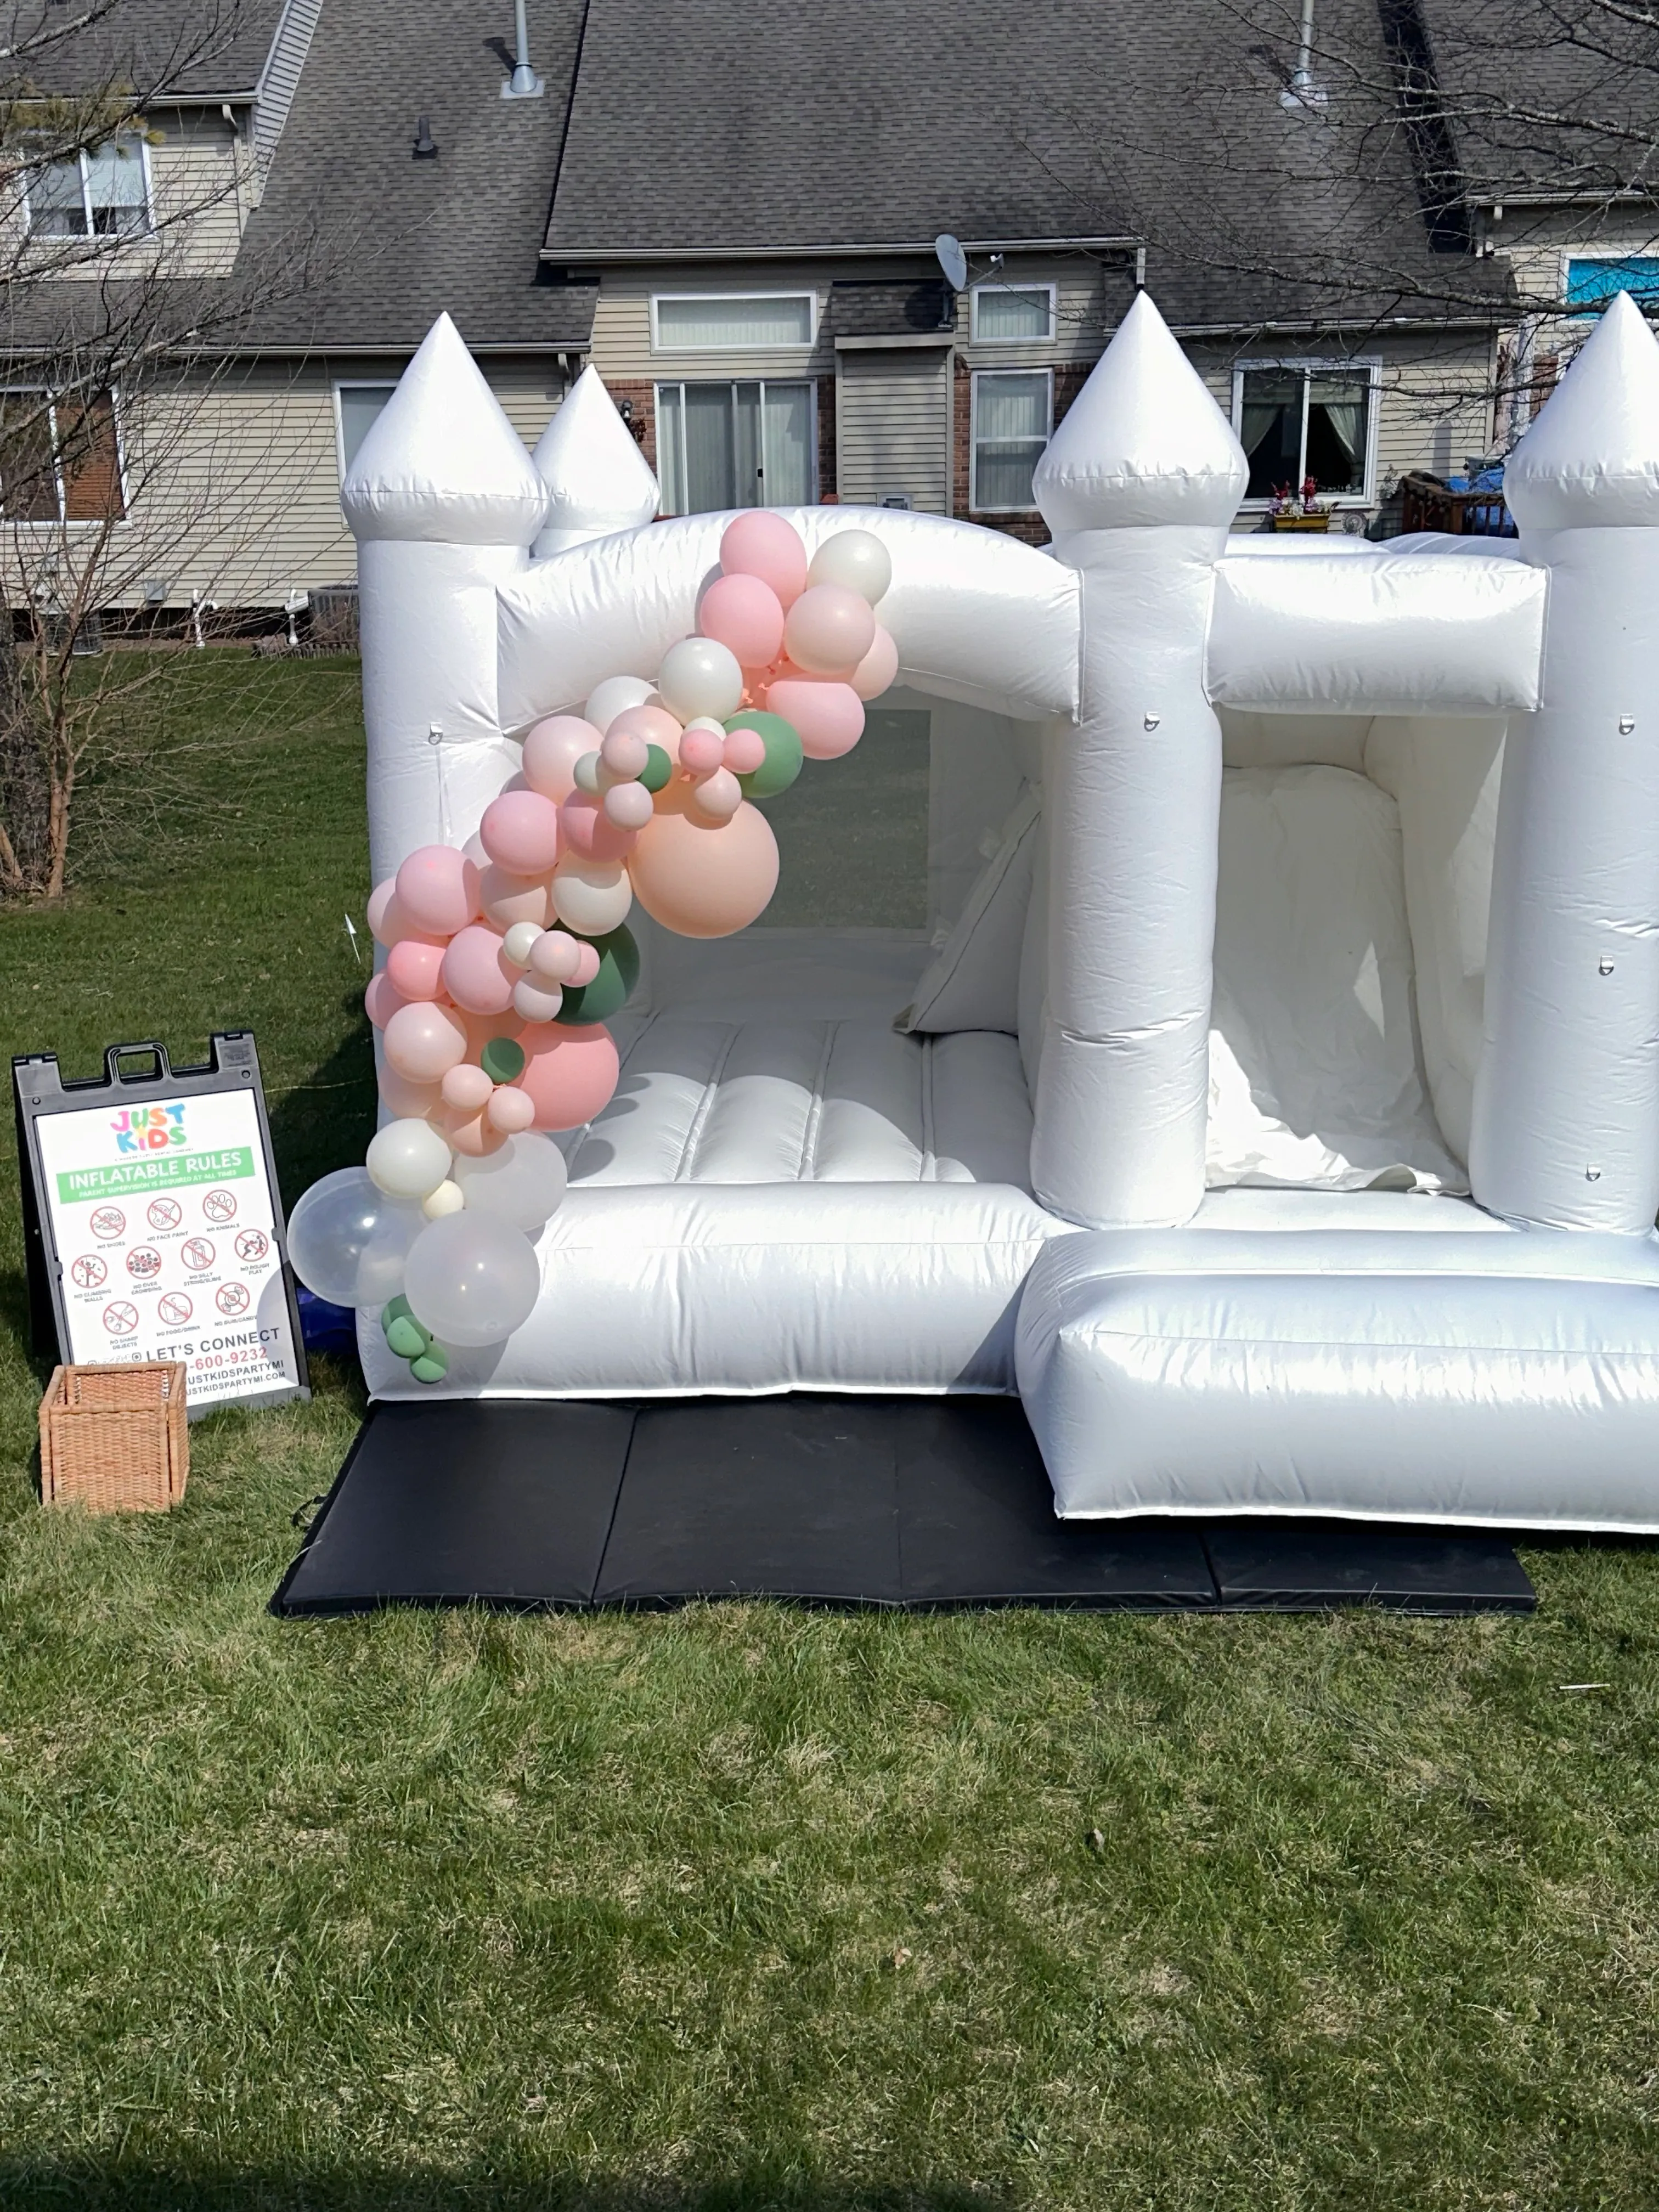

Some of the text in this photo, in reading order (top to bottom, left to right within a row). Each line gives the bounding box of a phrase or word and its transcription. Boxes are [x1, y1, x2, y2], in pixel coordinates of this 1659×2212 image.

[110, 1103, 185, 1132] JUST
[116, 1126, 187, 1154] KIDS
[69, 1160, 180, 1190] INFLATABLE
[185, 1152, 242, 1173] RULES
[79, 1188, 105, 1198] PARENT
[107, 1182, 150, 1194] SUPERVISION
[159, 1177, 192, 1187] REQUIRED
[146, 1327, 280, 1362] LET'S CONNECT
[189, 1346, 268, 1370] -600-9232
[187, 1371, 285, 1396] USTKIDSPARTYMI.COM
[188, 1360, 284, 1385] USTKIDSPARTYMI
